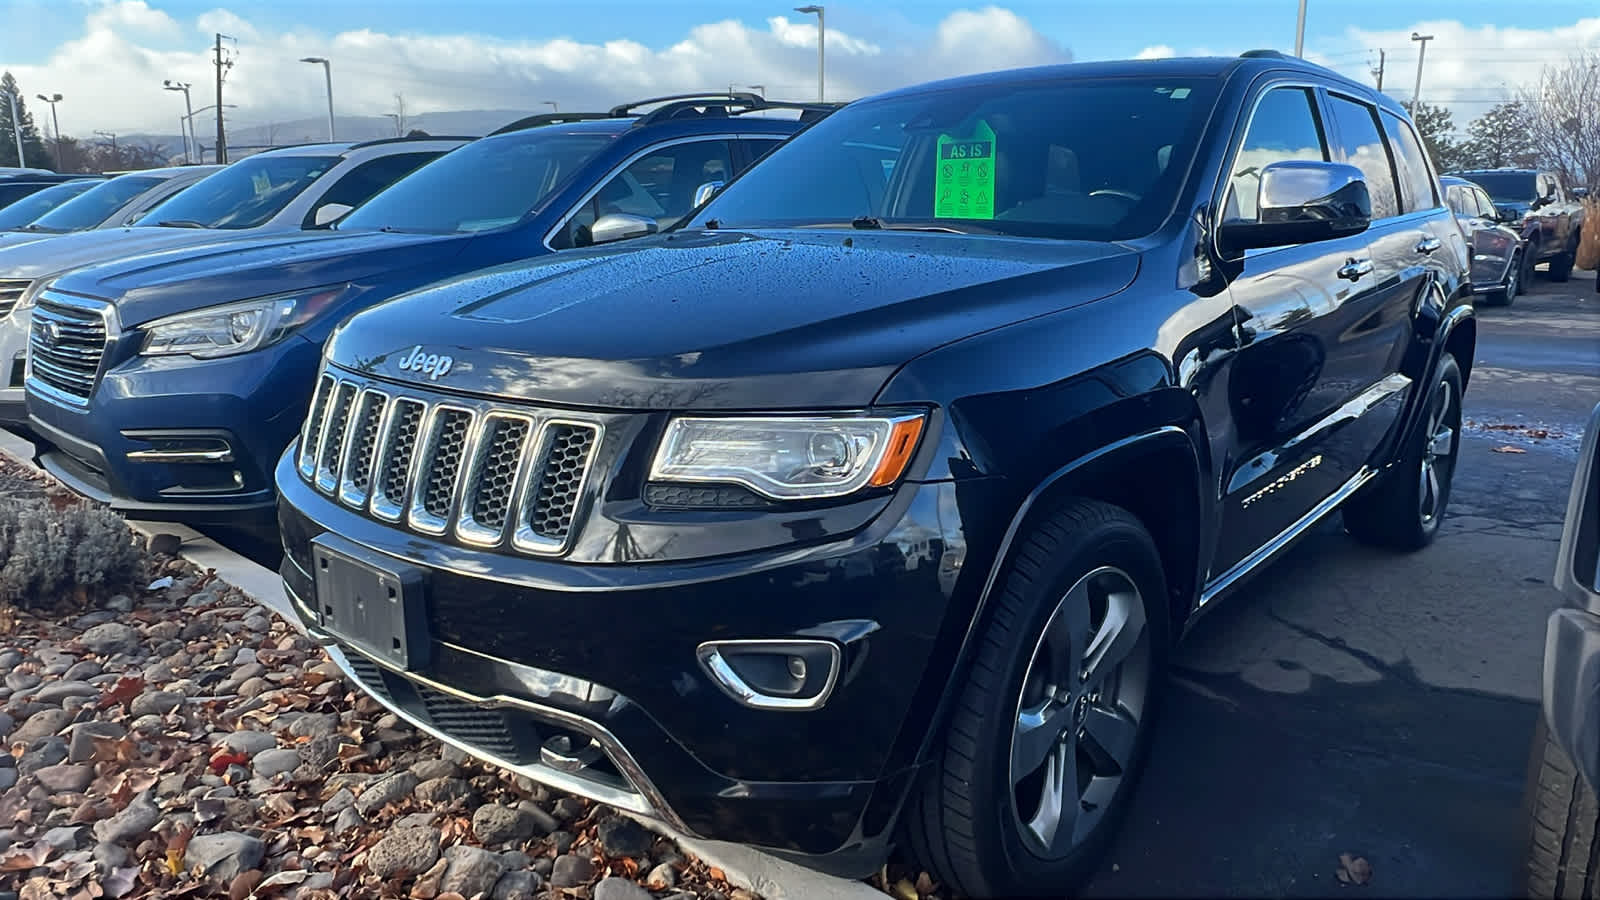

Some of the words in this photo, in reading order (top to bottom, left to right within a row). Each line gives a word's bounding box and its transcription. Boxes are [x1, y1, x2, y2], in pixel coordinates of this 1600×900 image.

[950, 144, 966, 158] AS
[970, 143, 983, 157] IS
[399, 345, 453, 380] Jeep
